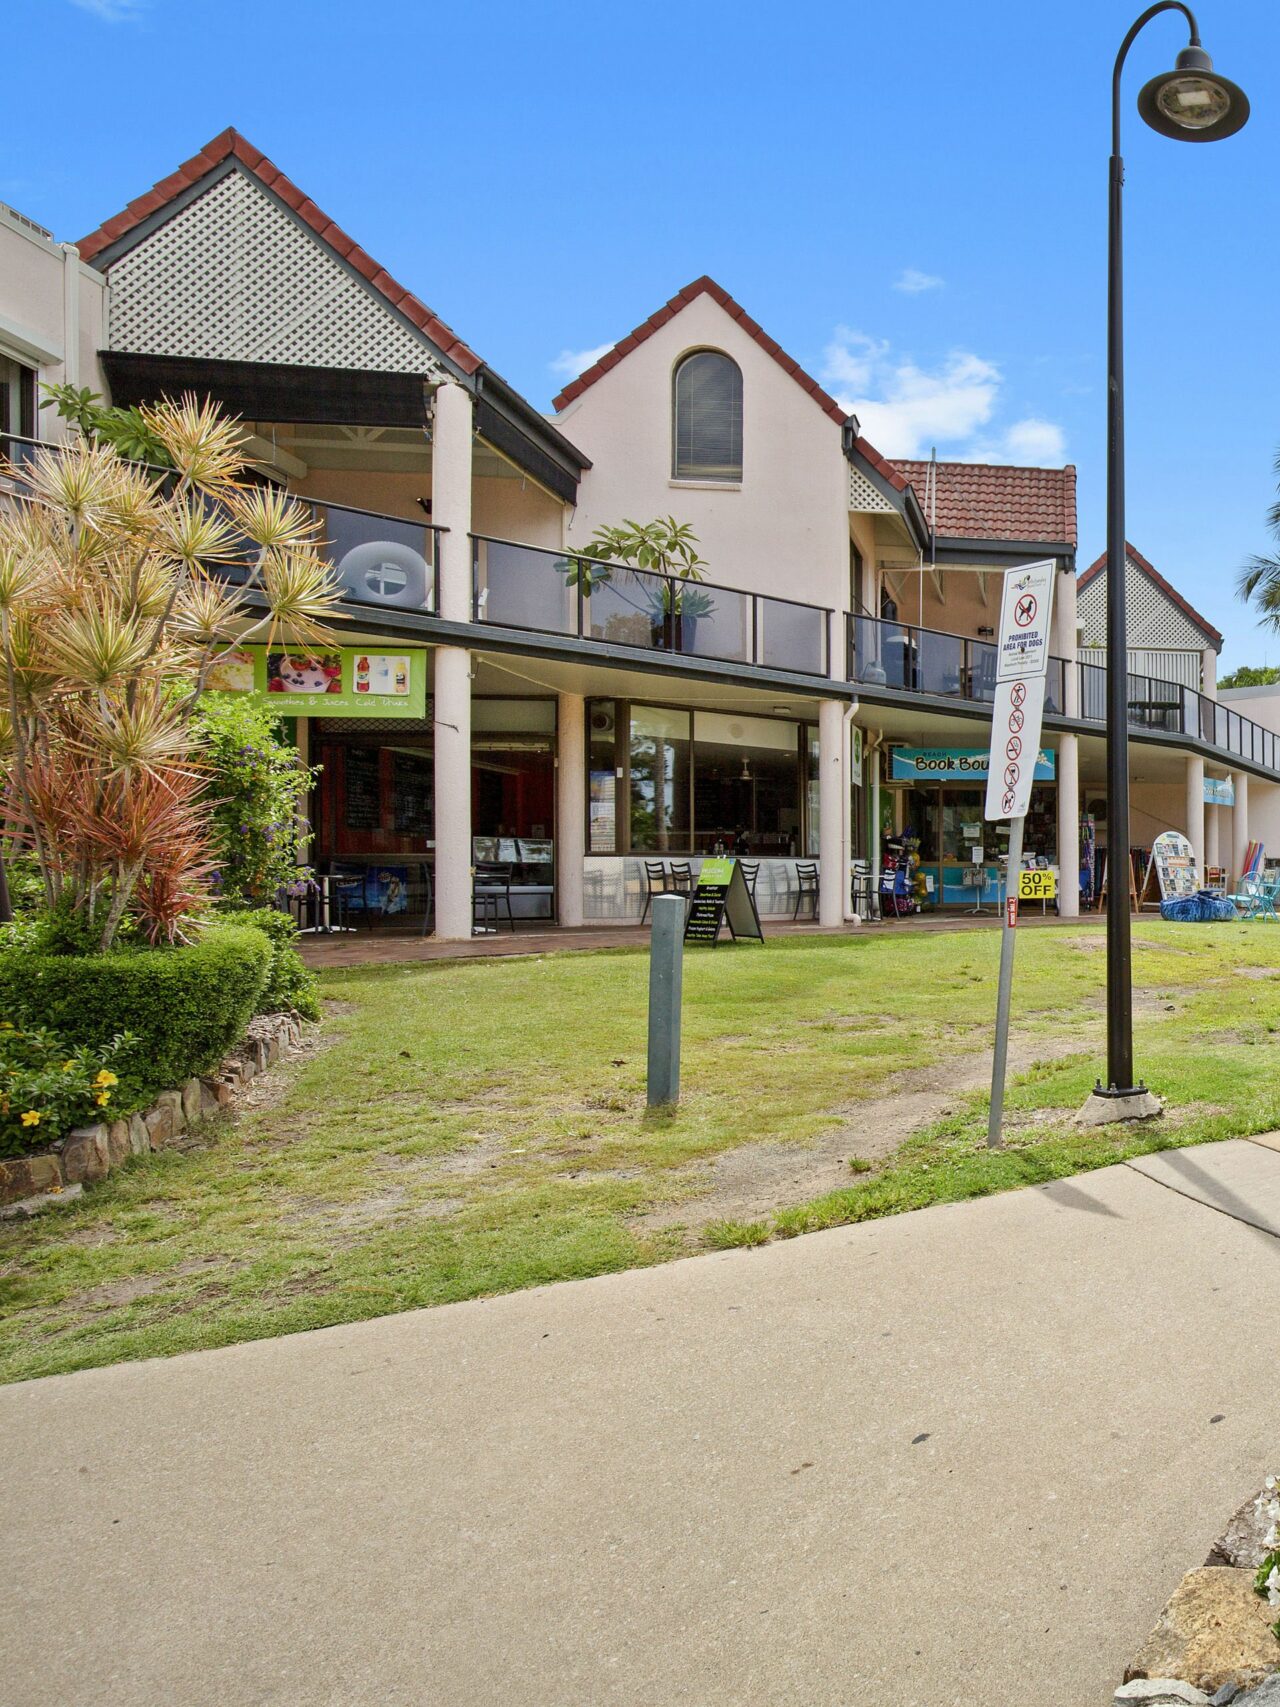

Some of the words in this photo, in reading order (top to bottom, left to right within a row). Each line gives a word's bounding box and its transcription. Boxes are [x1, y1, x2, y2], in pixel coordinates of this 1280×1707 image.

[1008, 631, 1038, 642] PROHIBITED
[1003, 642, 1016, 651] AREA
[1017, 640, 1028, 648] FOR
[1029, 639, 1042, 647] DOGS
[915, 756, 955, 770] Book
[959, 757, 990, 771] Bou
[1021, 885, 1051, 896] OFF
